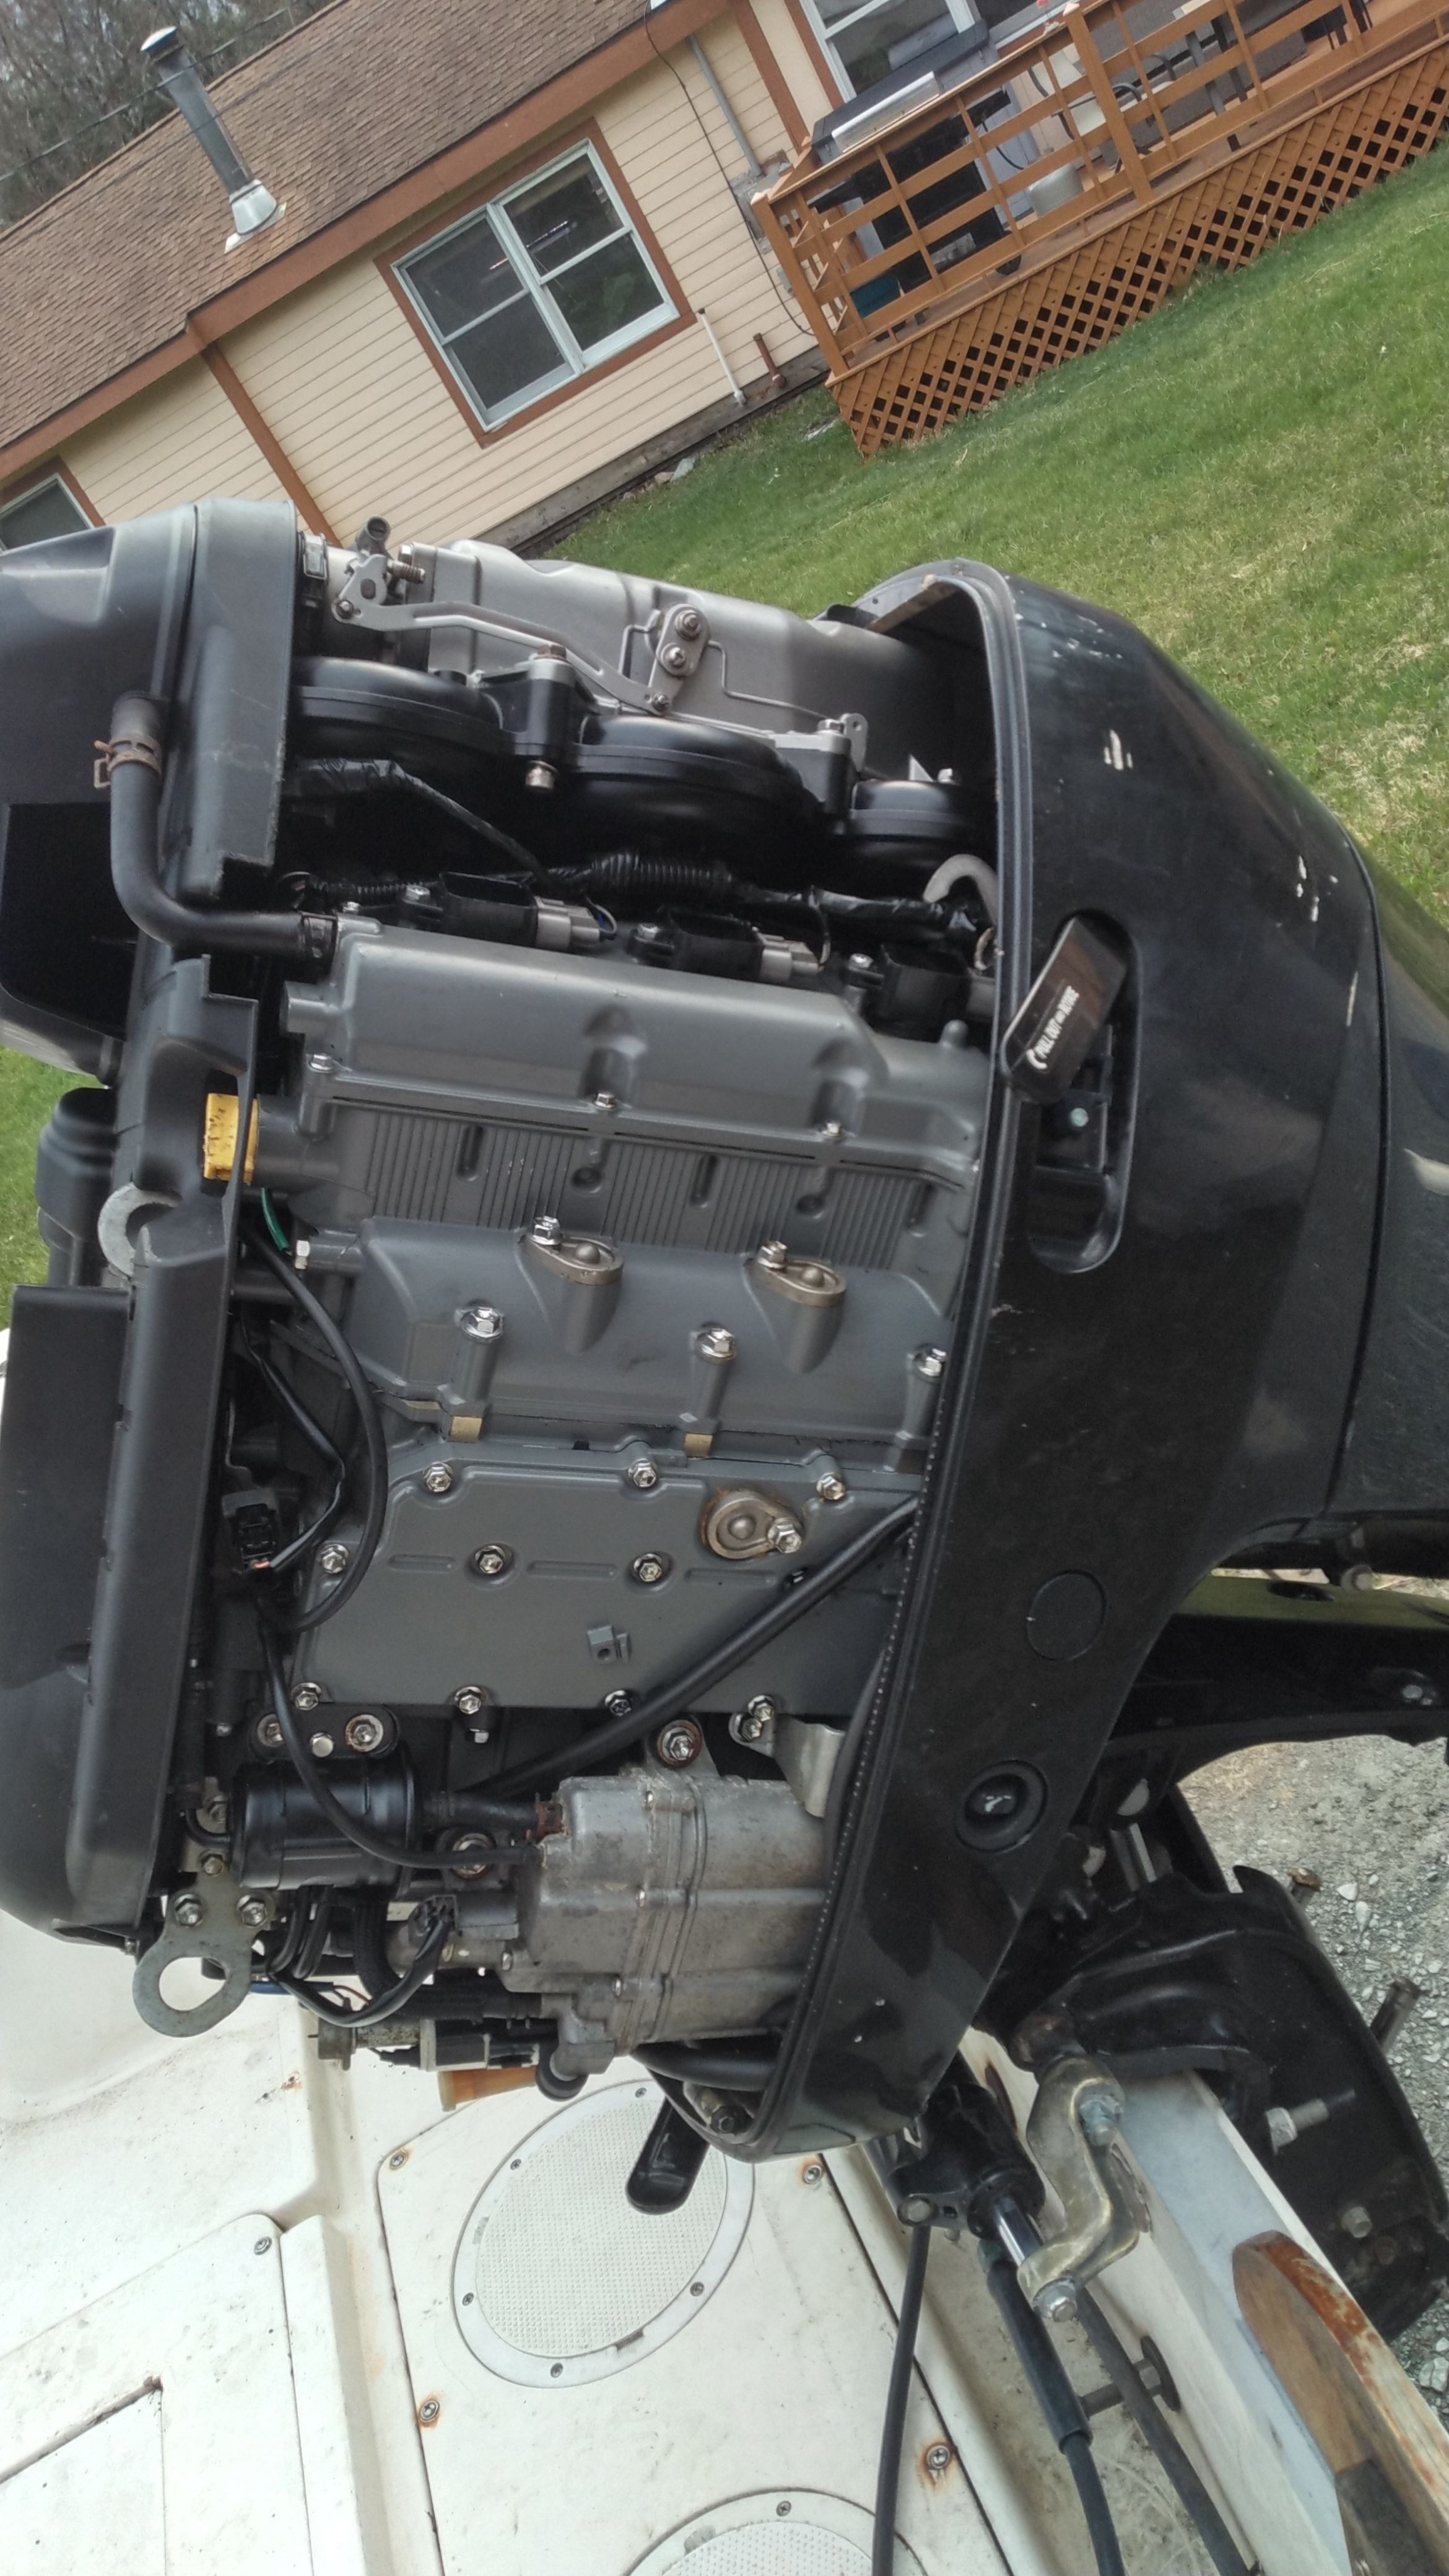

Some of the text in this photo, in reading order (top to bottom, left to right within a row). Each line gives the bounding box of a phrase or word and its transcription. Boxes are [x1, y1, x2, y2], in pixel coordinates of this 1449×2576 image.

[1057, 985, 1079, 1016] ROTATE
[1043, 1017, 1063, 1040] OUT
[1033, 1034, 1055, 1060] PULL
